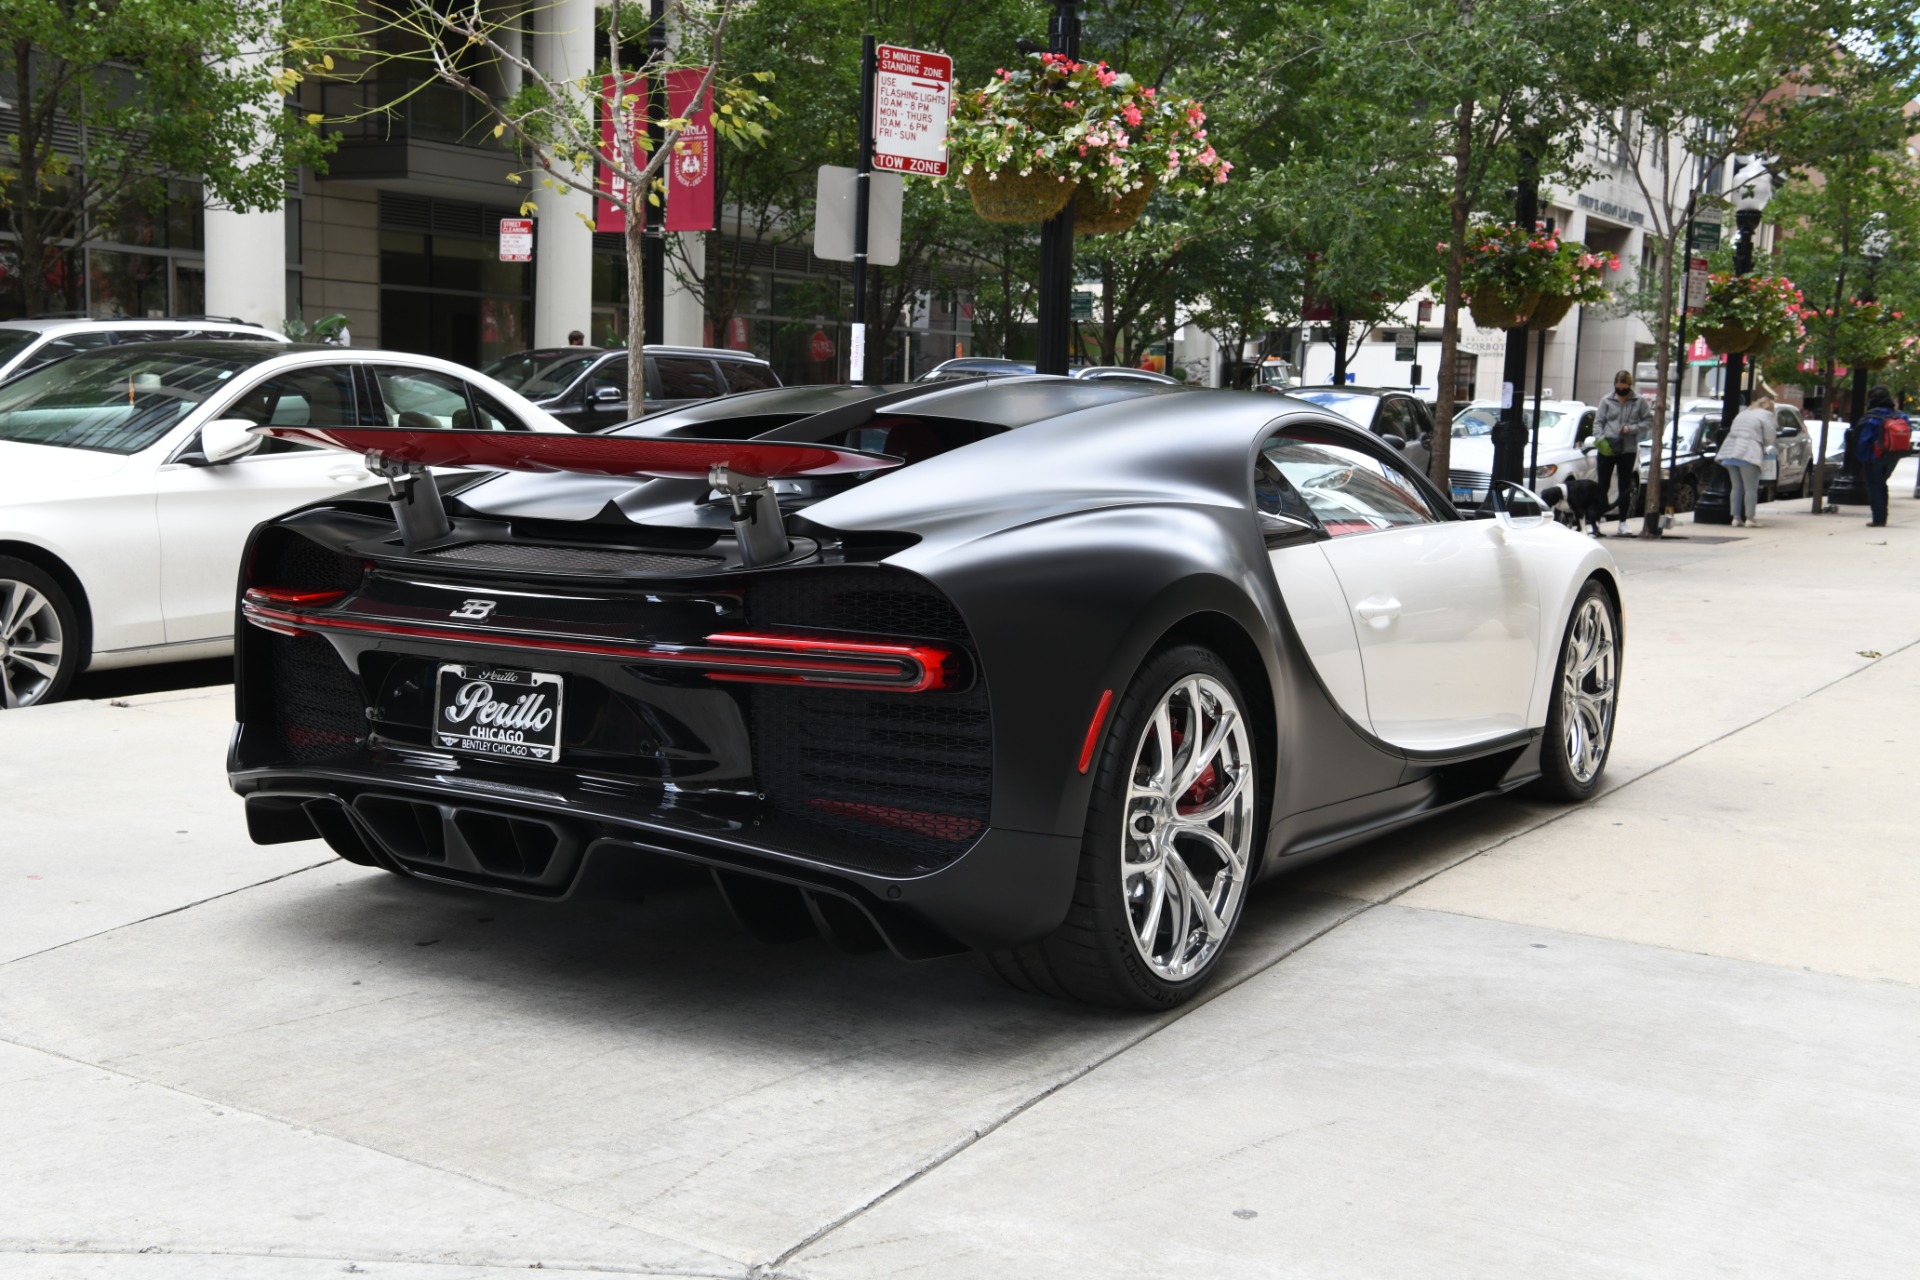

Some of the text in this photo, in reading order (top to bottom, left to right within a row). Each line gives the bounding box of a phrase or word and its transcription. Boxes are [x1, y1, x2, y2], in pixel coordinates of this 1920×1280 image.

[882, 49, 921, 64] 15 MINUTE
[882, 60, 944, 78] STANDING ZONE
[881, 76, 896, 86] USE
[880, 87, 946, 105] FLASHING LIGHTS
[880, 97, 889, 106] 10
[890, 98, 902, 108] AM
[910, 101, 916, 110] 8
[918, 102, 930, 112] PM
[880, 106, 898, 118] MON
[906, 110, 932, 123] THURS
[880, 118, 888, 126] 10
[889, 118, 901, 128] AM
[910, 122, 914, 130] 6
[916, 122, 928, 132] PM
[880, 128, 892, 138] FRI
[900, 130, 916, 141] SUN
[878, 154, 942, 174] TOW ZONE
[478, 670, 518, 682] Perillo
[444, 681, 552, 732] Perillo
[470, 726, 524, 743] CHICAGO
[462, 739, 528, 756] BENTLEY CHICAGO
